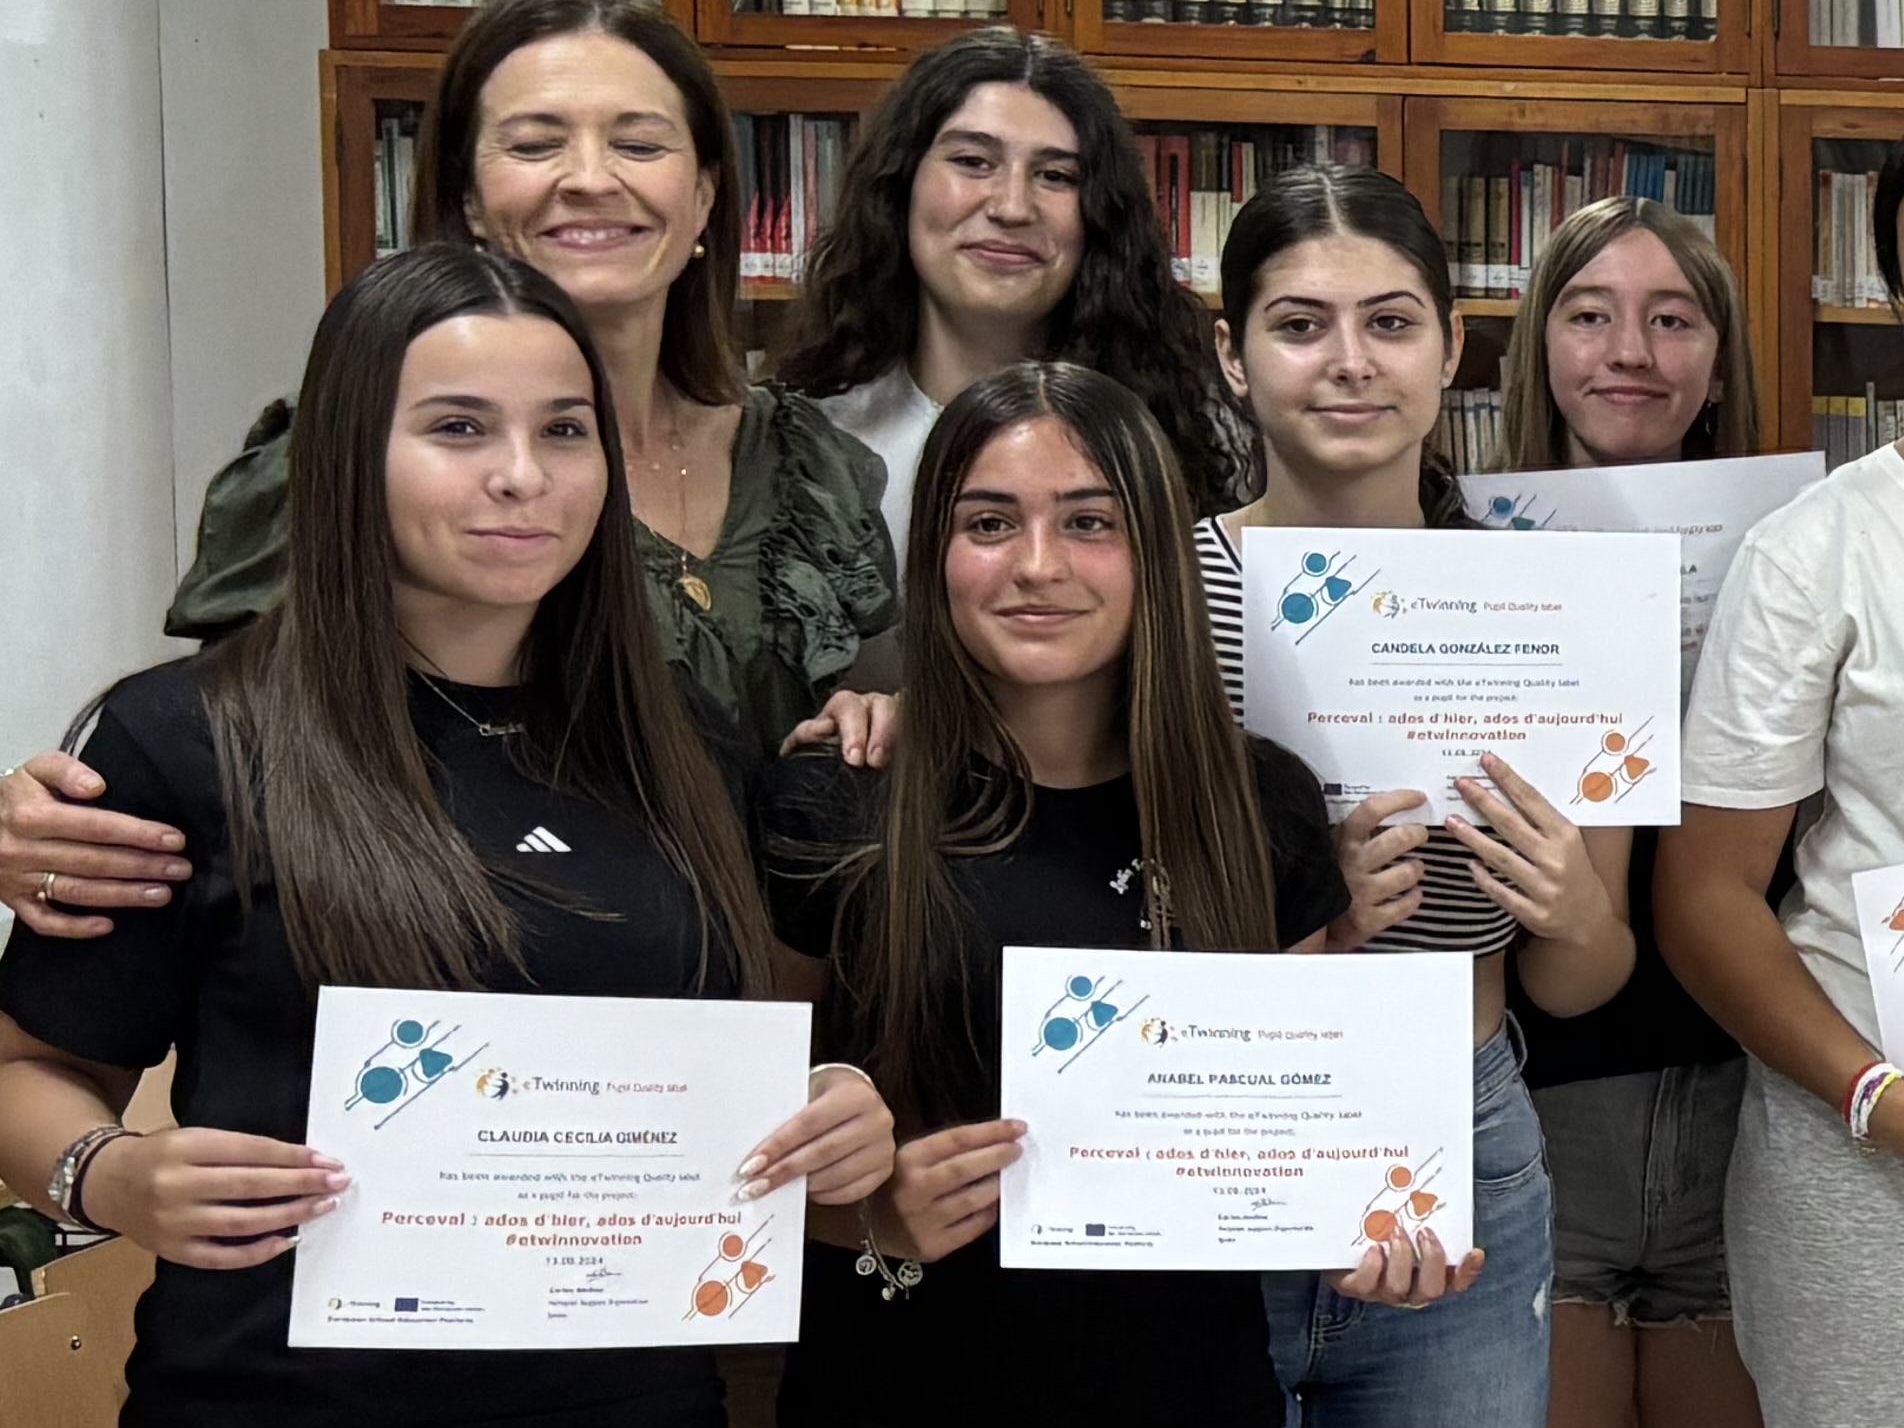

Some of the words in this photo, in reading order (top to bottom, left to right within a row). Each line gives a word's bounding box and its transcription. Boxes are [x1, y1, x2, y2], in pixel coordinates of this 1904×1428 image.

[1410, 596, 1477, 614] eTwinning
[1371, 642, 1435, 654] CANDELA
[1438, 641, 1511, 654] GONZÁLEZ
[1307, 711, 1372, 723] Perceval
[1387, 712, 1424, 724] ados
[1429, 712, 1477, 725] d'hier,
[1483, 712, 1519, 724] ados
[1523, 712, 1622, 726] d'aujourd'hui
[522, 1075, 600, 1096] eTwinning
[1147, 1073, 1204, 1084] ANABEL
[1280, 1072, 1331, 1085] GÓMEZ
[477, 1129, 549, 1143] CLAUDIA
[553, 1130, 612, 1144] CECILIA
[1069, 1146, 1140, 1158] Perceval
[1155, 1147, 1194, 1159] ados
[1199, 1147, 1250, 1160] d'hier,
[1257, 1148, 1296, 1160] ados
[1301, 1144, 1408, 1160] d'aujourd'hui
[381, 1211, 465, 1225] Perceval
[484, 1213, 530, 1228] ados
[534, 1213, 590, 1228] d'hier,
[596, 1213, 636, 1226] ados
[640, 1211, 741, 1228] d'aujourd'hui
